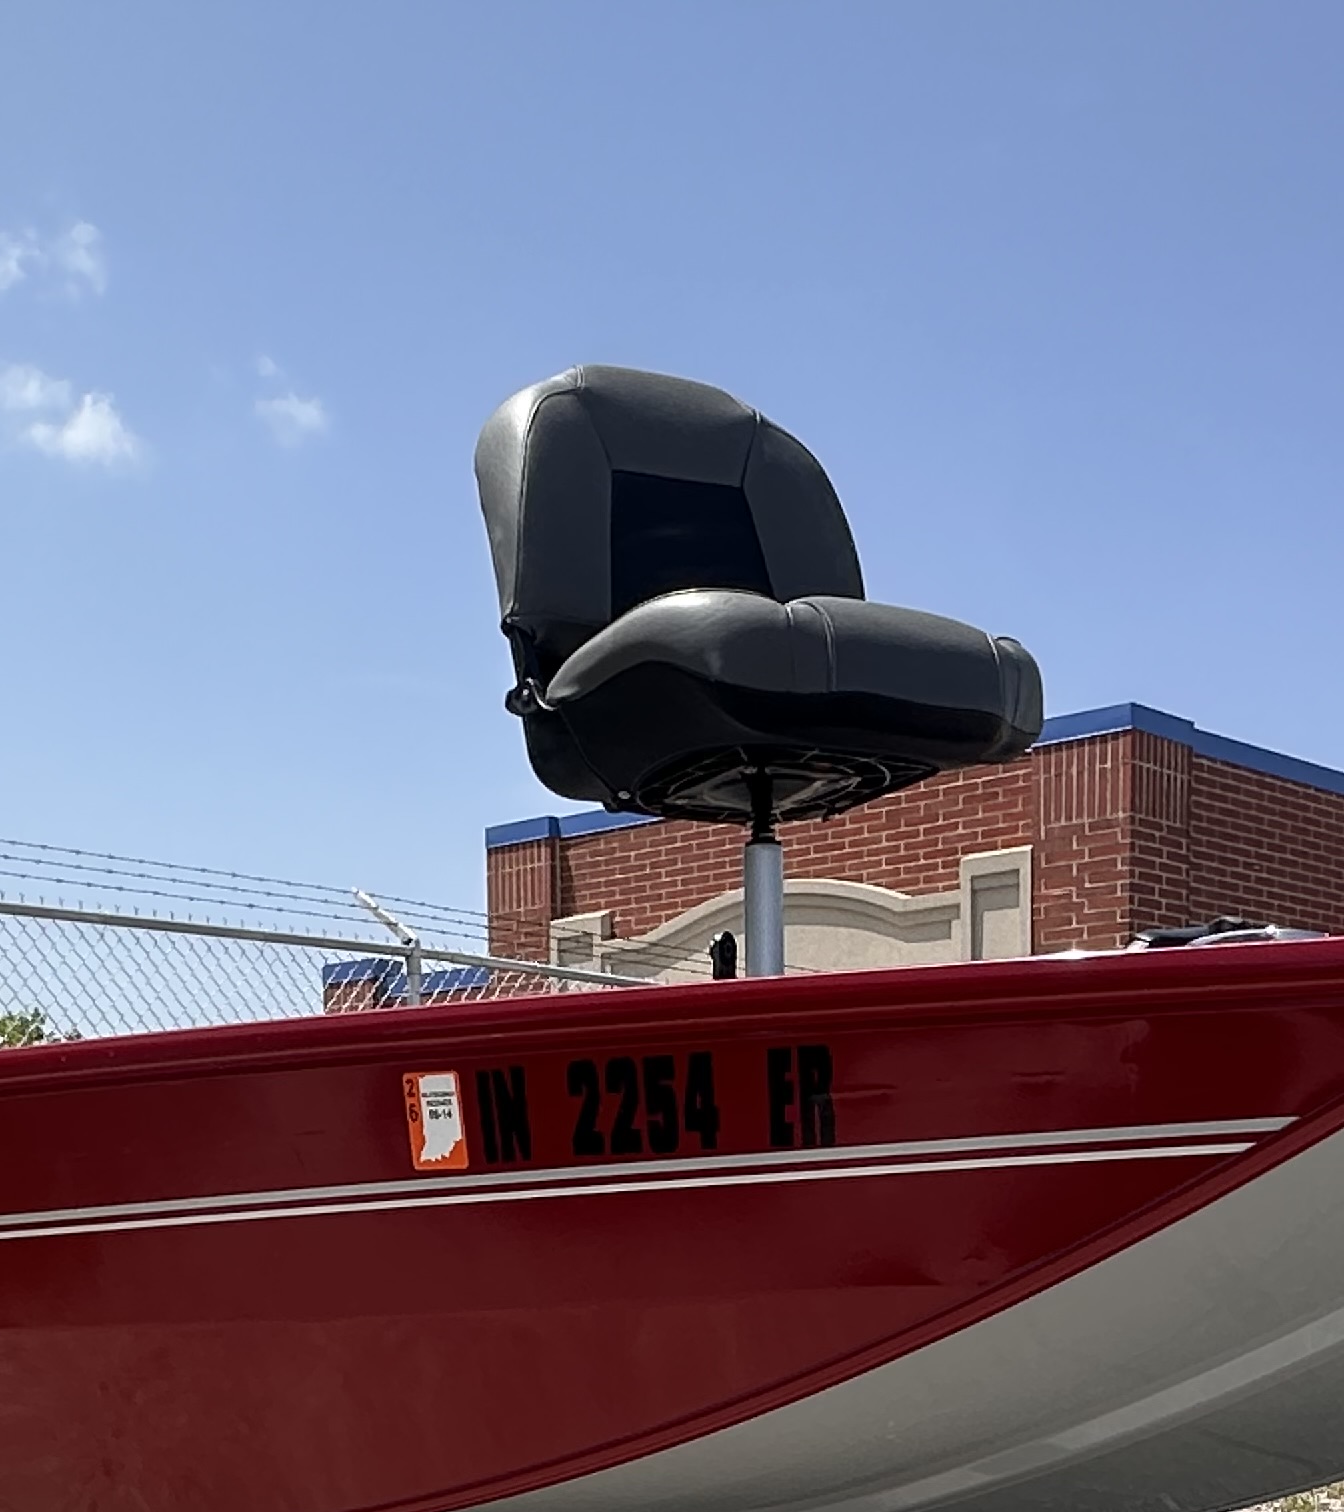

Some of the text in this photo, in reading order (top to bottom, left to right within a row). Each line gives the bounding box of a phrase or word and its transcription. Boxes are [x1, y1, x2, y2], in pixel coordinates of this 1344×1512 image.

[475, 1044, 836, 1163] IN 2254 ER
